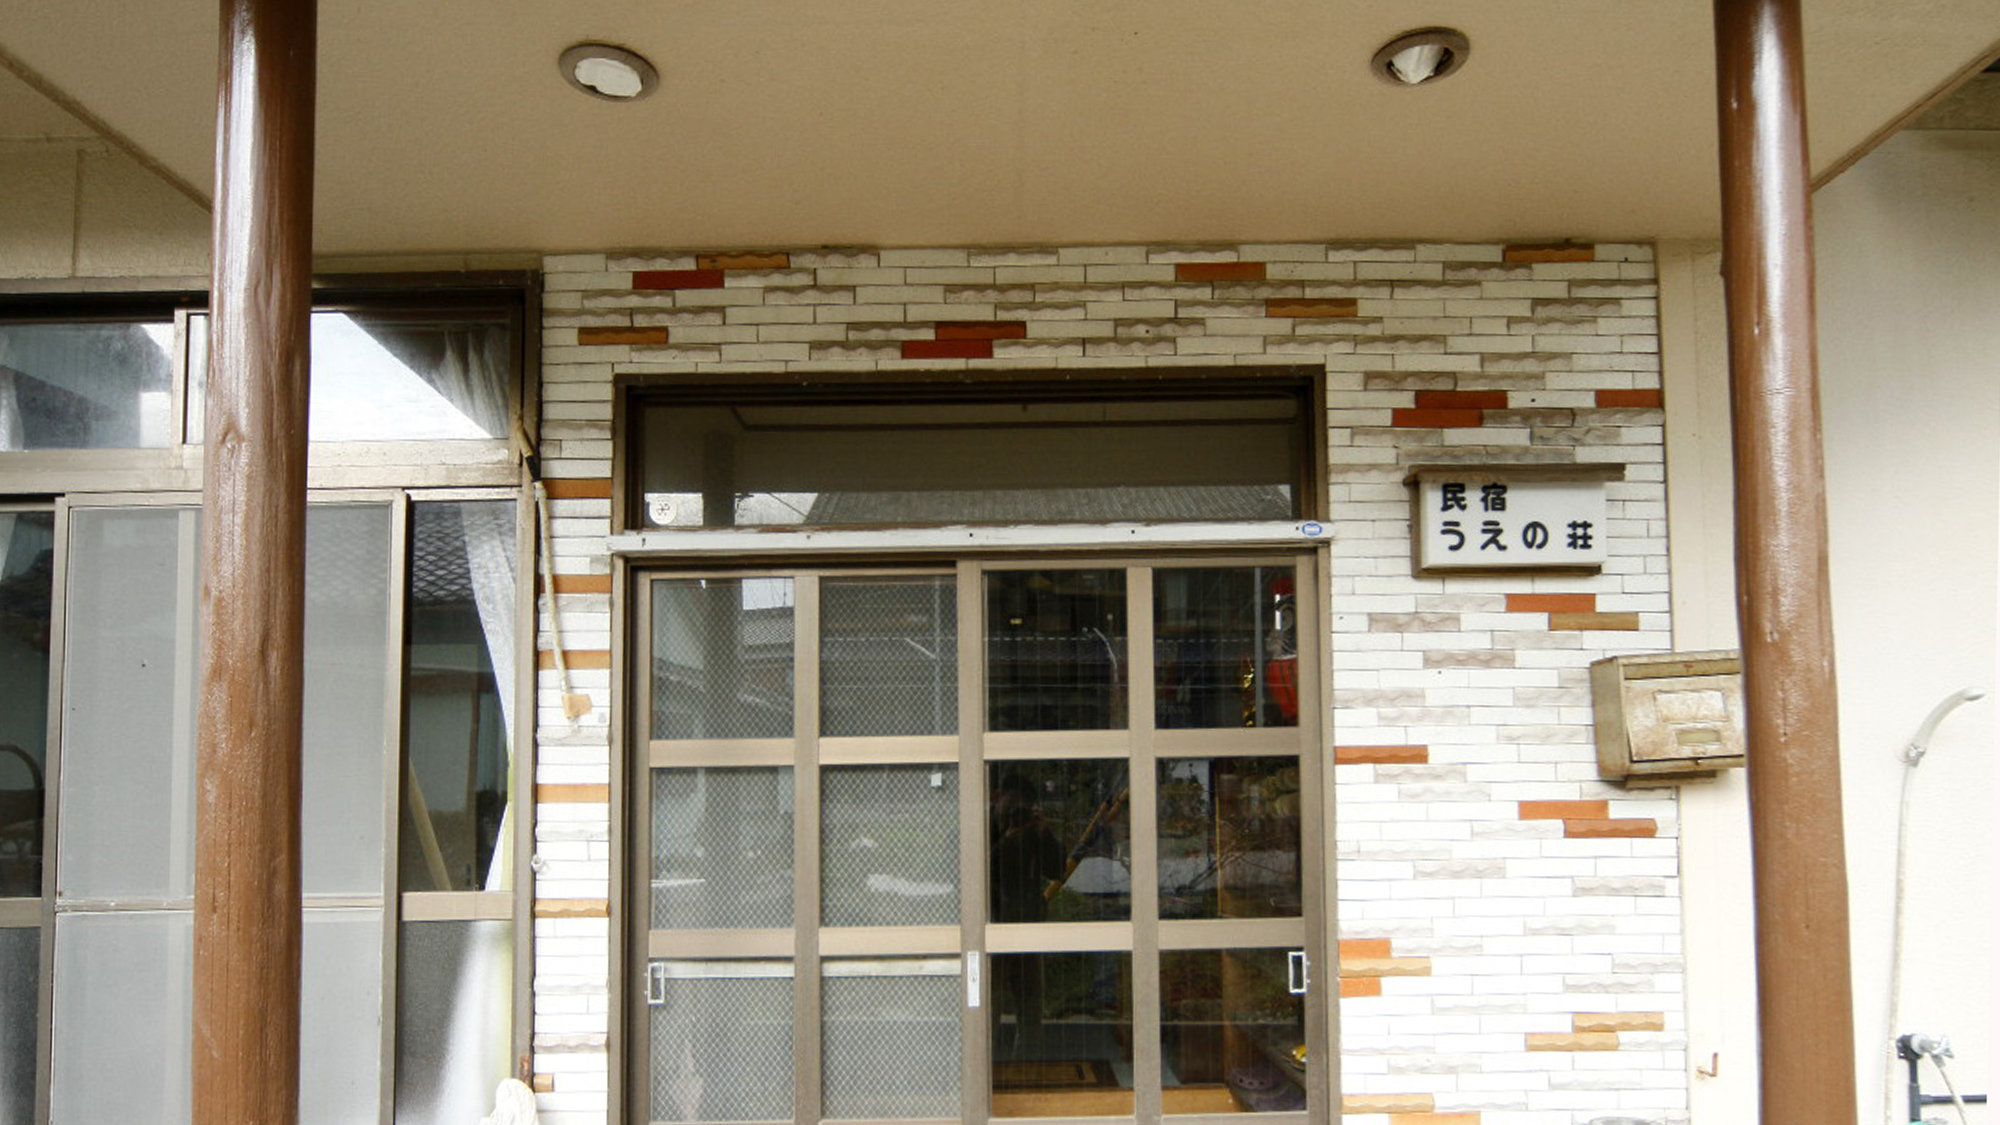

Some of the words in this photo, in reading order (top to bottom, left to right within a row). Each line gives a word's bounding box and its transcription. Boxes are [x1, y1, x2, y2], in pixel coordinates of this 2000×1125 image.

[1440, 482, 1508, 512] 民宿
[1440, 520, 1593, 551] うえの荘
